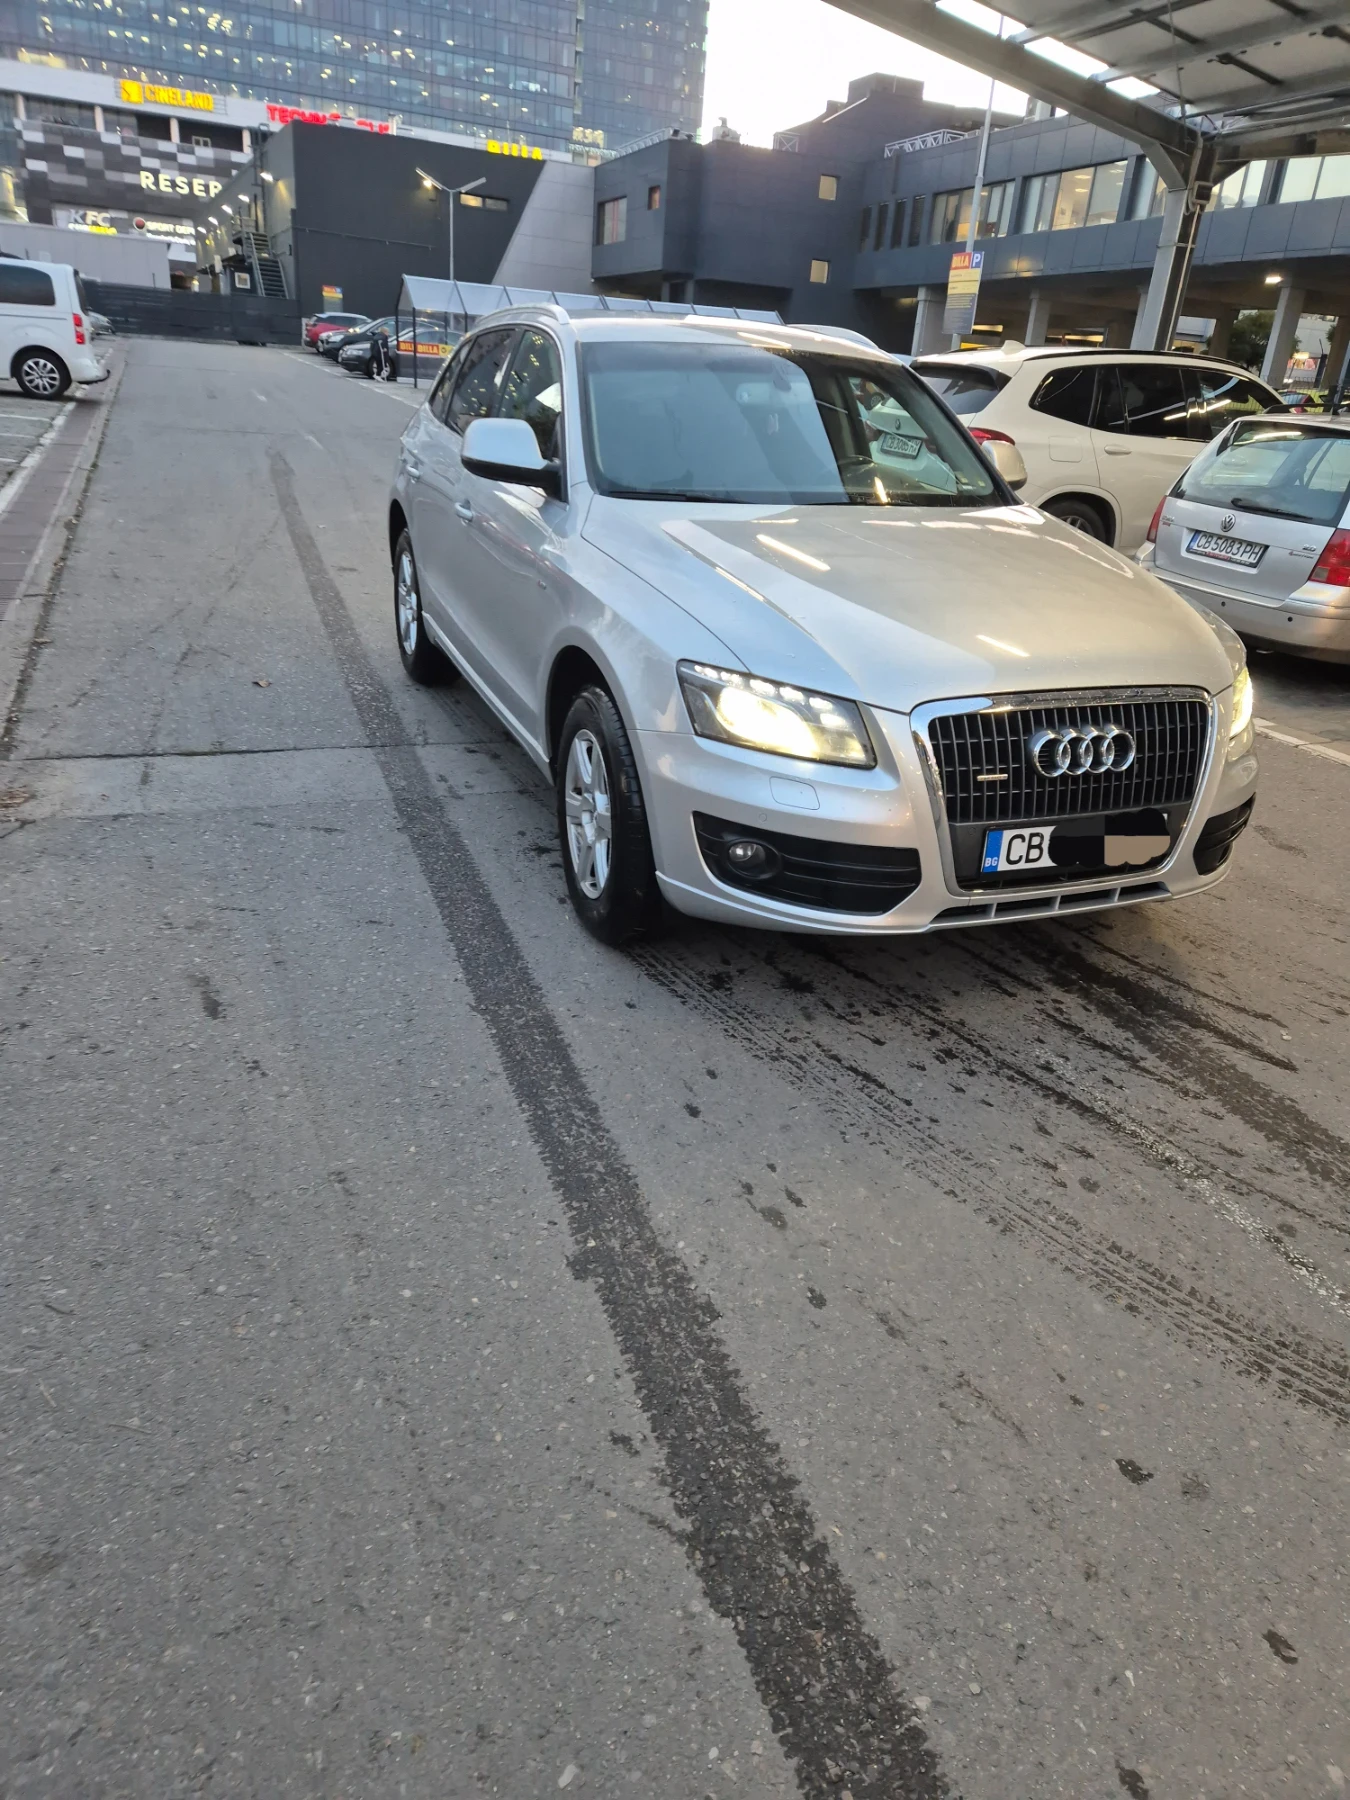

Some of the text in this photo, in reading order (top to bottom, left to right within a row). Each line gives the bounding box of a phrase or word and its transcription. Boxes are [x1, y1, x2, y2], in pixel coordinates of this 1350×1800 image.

[145, 83, 214, 112] CINELAND
[69, 209, 112, 227] KFC
[972, 253, 981, 267] P
[984, 832, 1045, 867] BG CB
